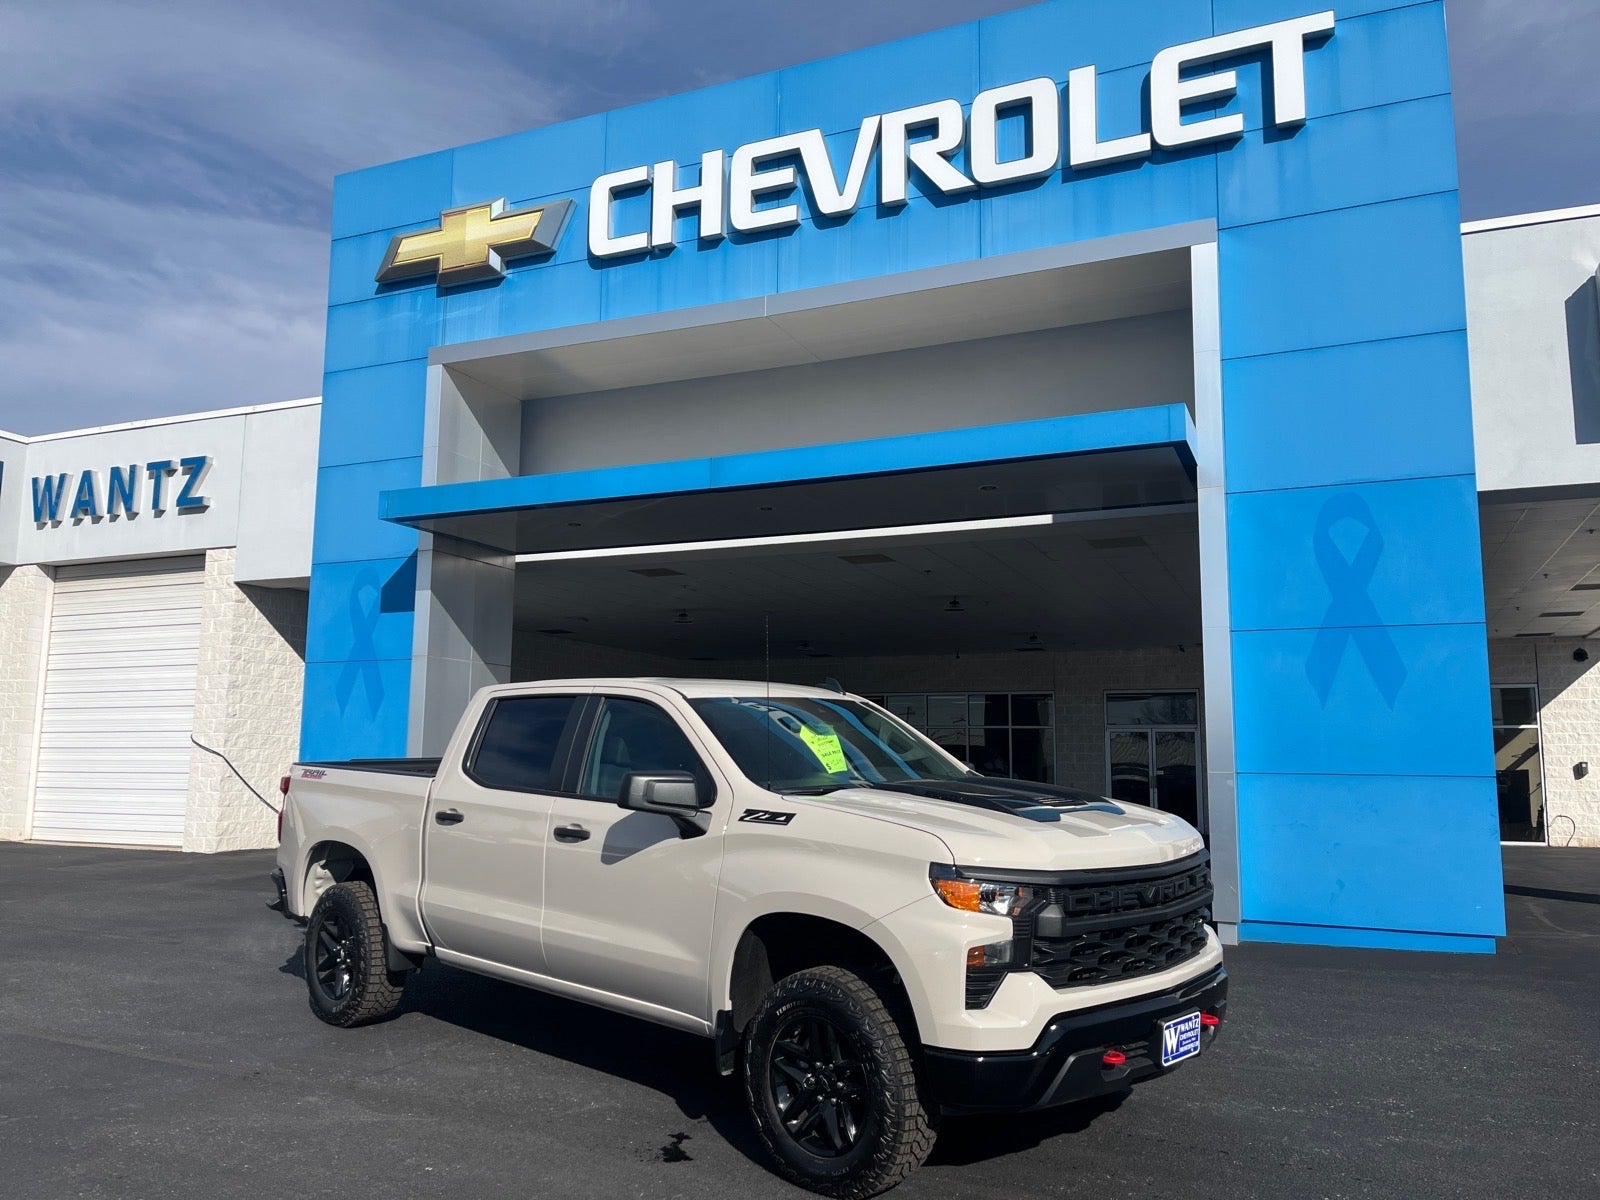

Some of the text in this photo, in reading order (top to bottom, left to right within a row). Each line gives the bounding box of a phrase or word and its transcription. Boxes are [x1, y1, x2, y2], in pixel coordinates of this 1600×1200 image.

[588, 11, 1336, 259] CHEVROLET
[32, 456, 213, 530] WANTZ
[302, 768, 328, 777] TRAIL
[738, 808, 797, 825] Z71
[1180, 1019, 1199, 1032] WANTZ
